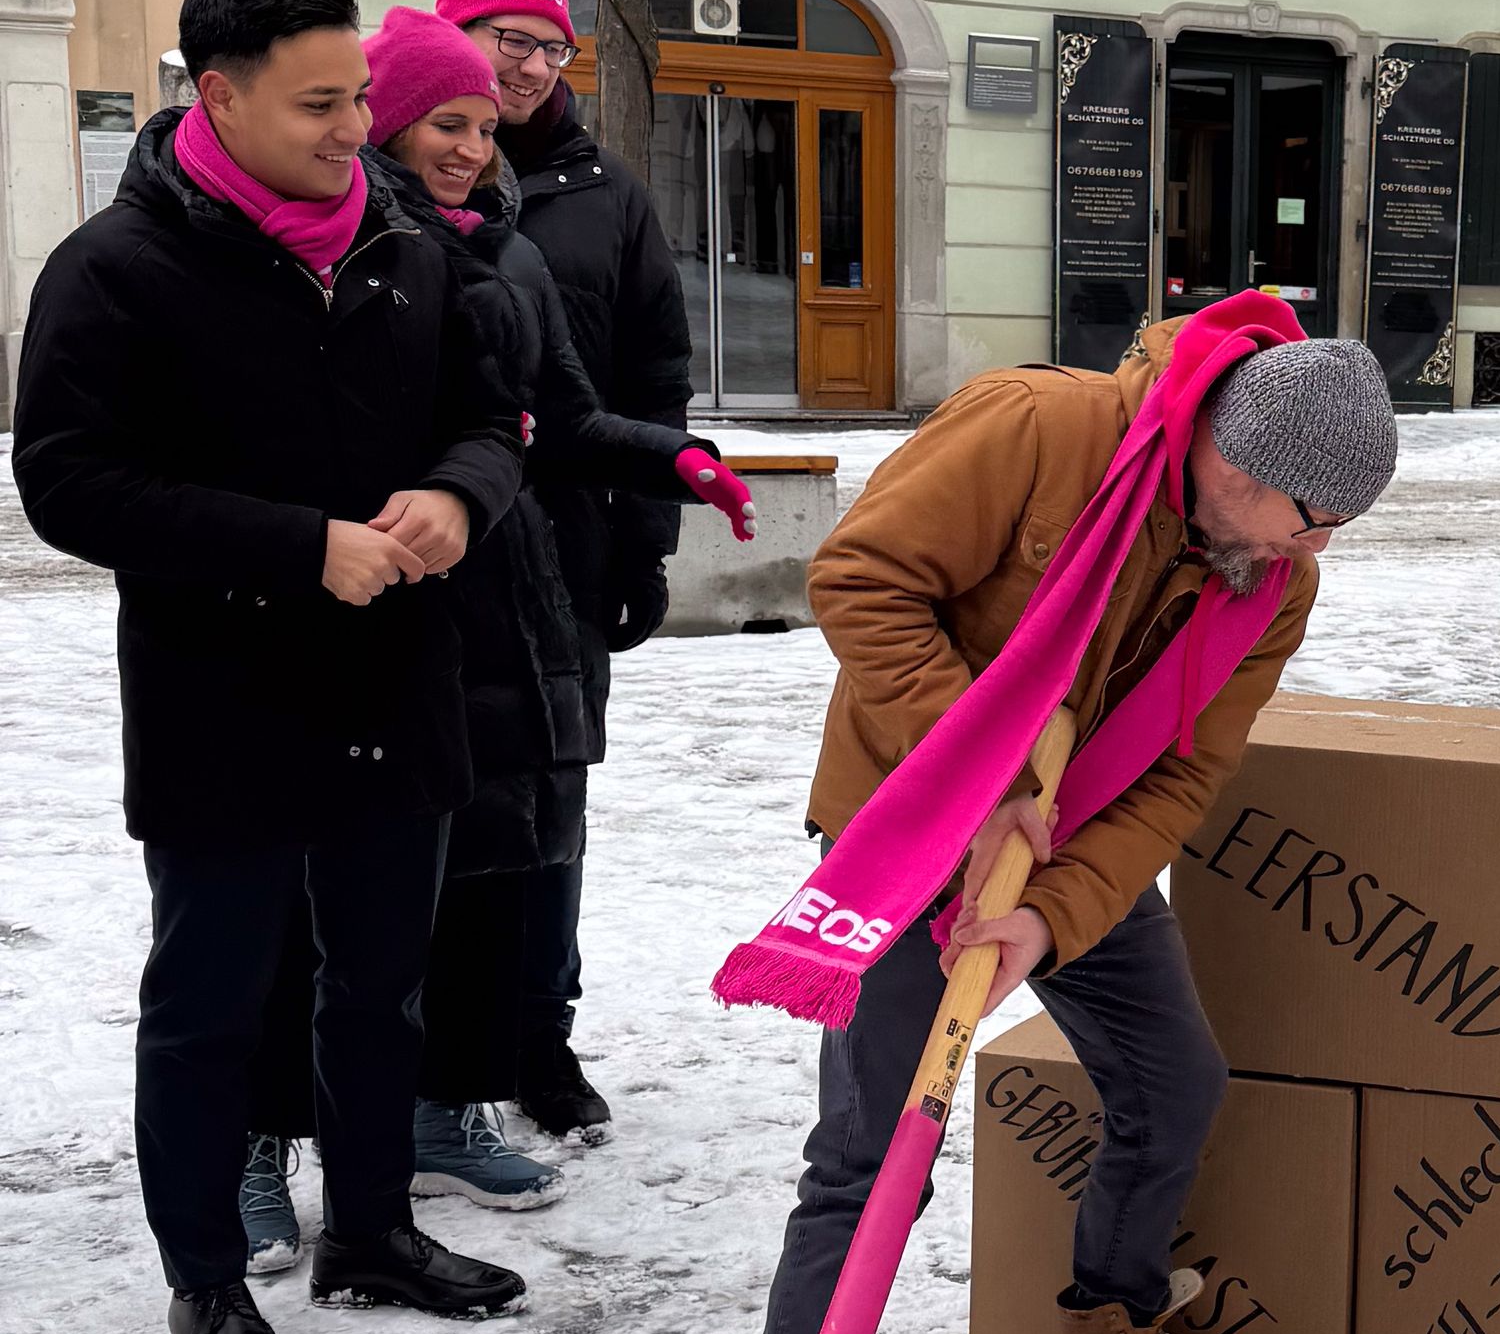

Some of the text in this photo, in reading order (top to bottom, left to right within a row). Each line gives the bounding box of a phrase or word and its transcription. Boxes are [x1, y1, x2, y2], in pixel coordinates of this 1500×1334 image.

[1082, 105, 1130, 115] KREMSERS
[1067, 113, 1130, 125] SCHATZTRUHE
[1397, 126, 1442, 135] KREMSERS
[1382, 134, 1442, 145] SCHATZTRUHE
